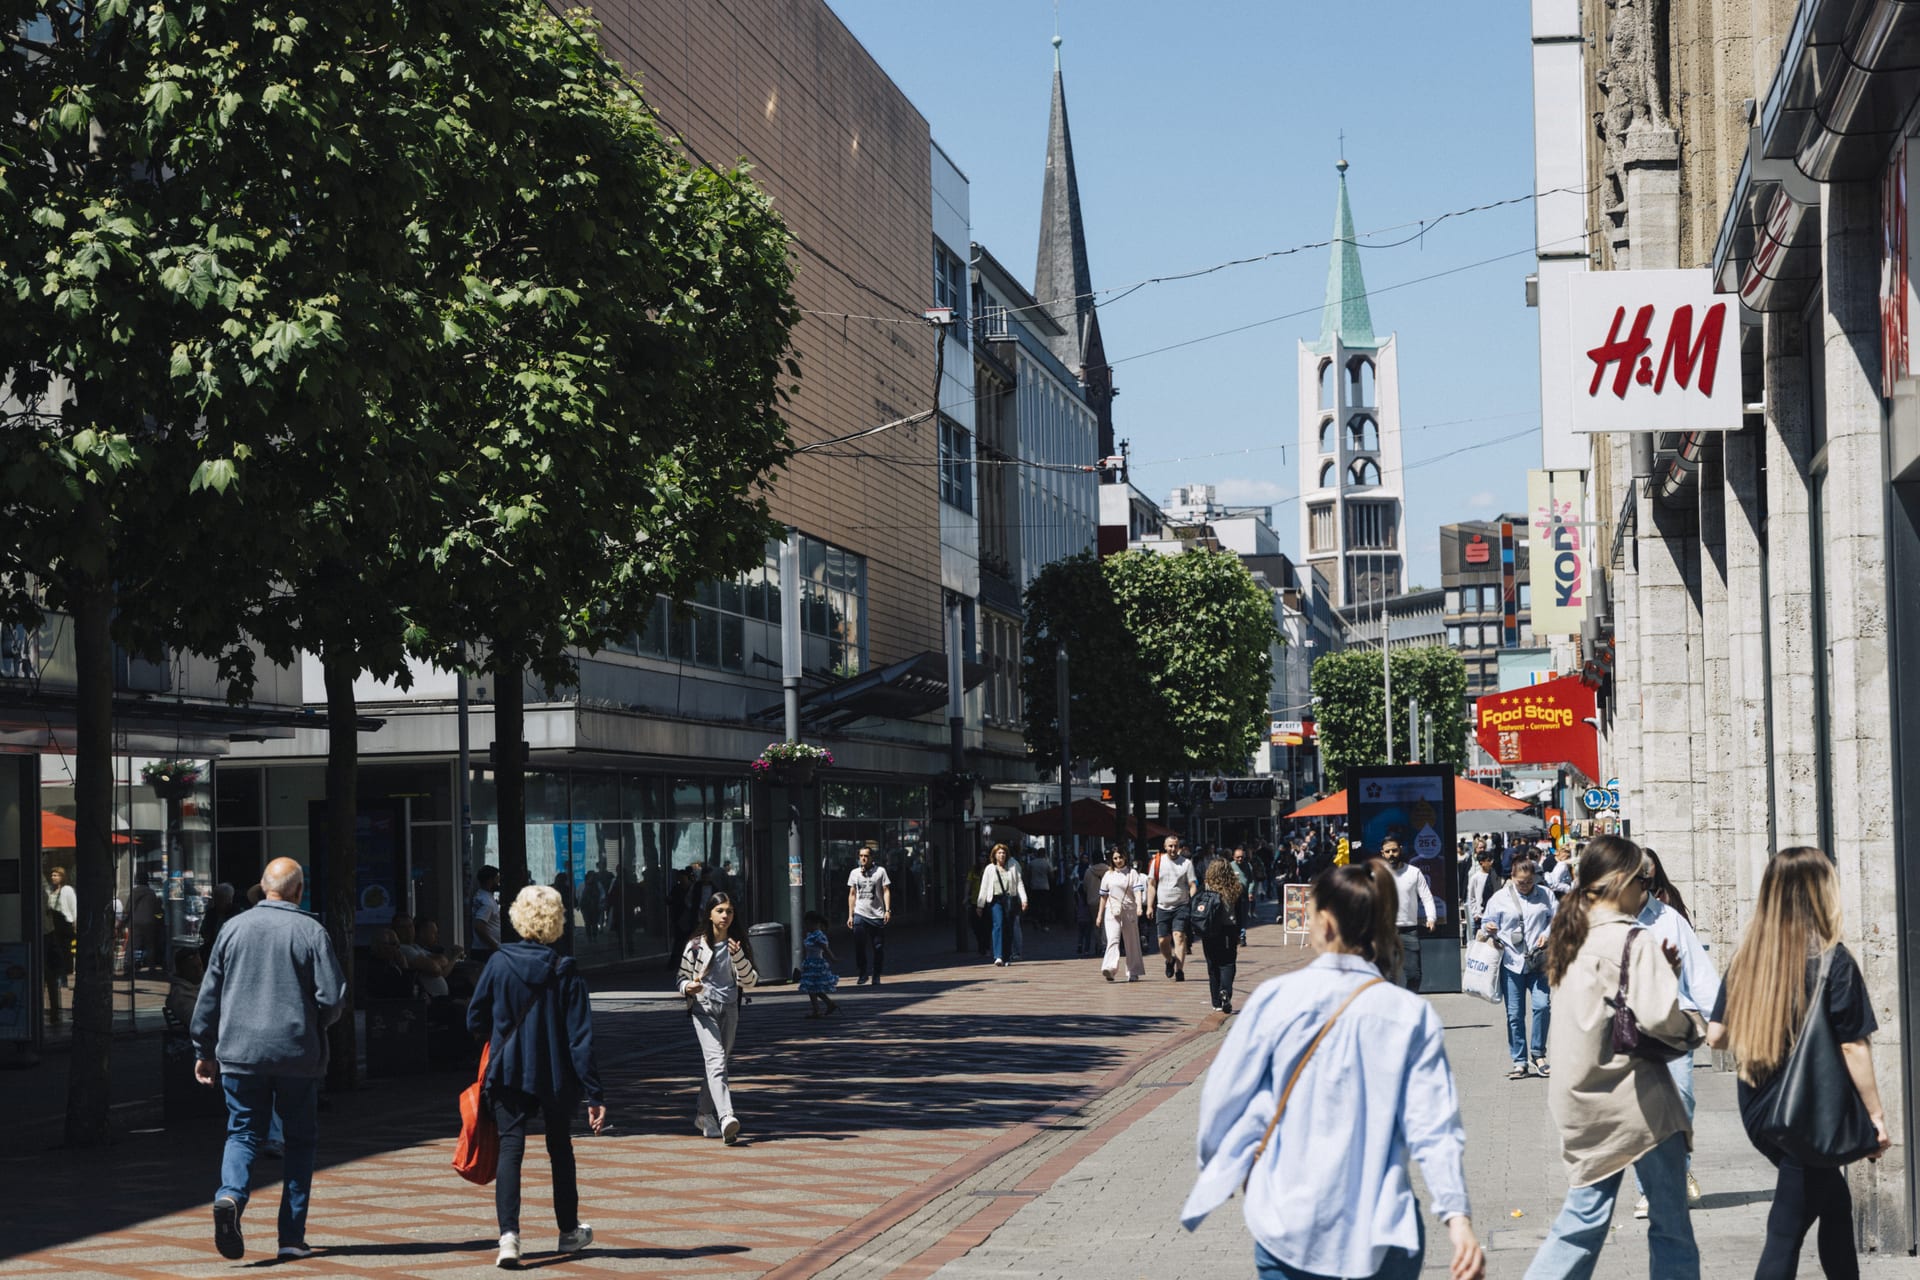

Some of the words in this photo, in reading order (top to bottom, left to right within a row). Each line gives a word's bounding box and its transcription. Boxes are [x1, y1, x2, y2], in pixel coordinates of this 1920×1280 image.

[1587, 303, 1726, 399] H&M
[1482, 707, 1522, 729] Food
[1525, 705, 1573, 727] Store
[1530, 722, 1560, 731] Currywurst
[1418, 839, 1430, 847] 25
